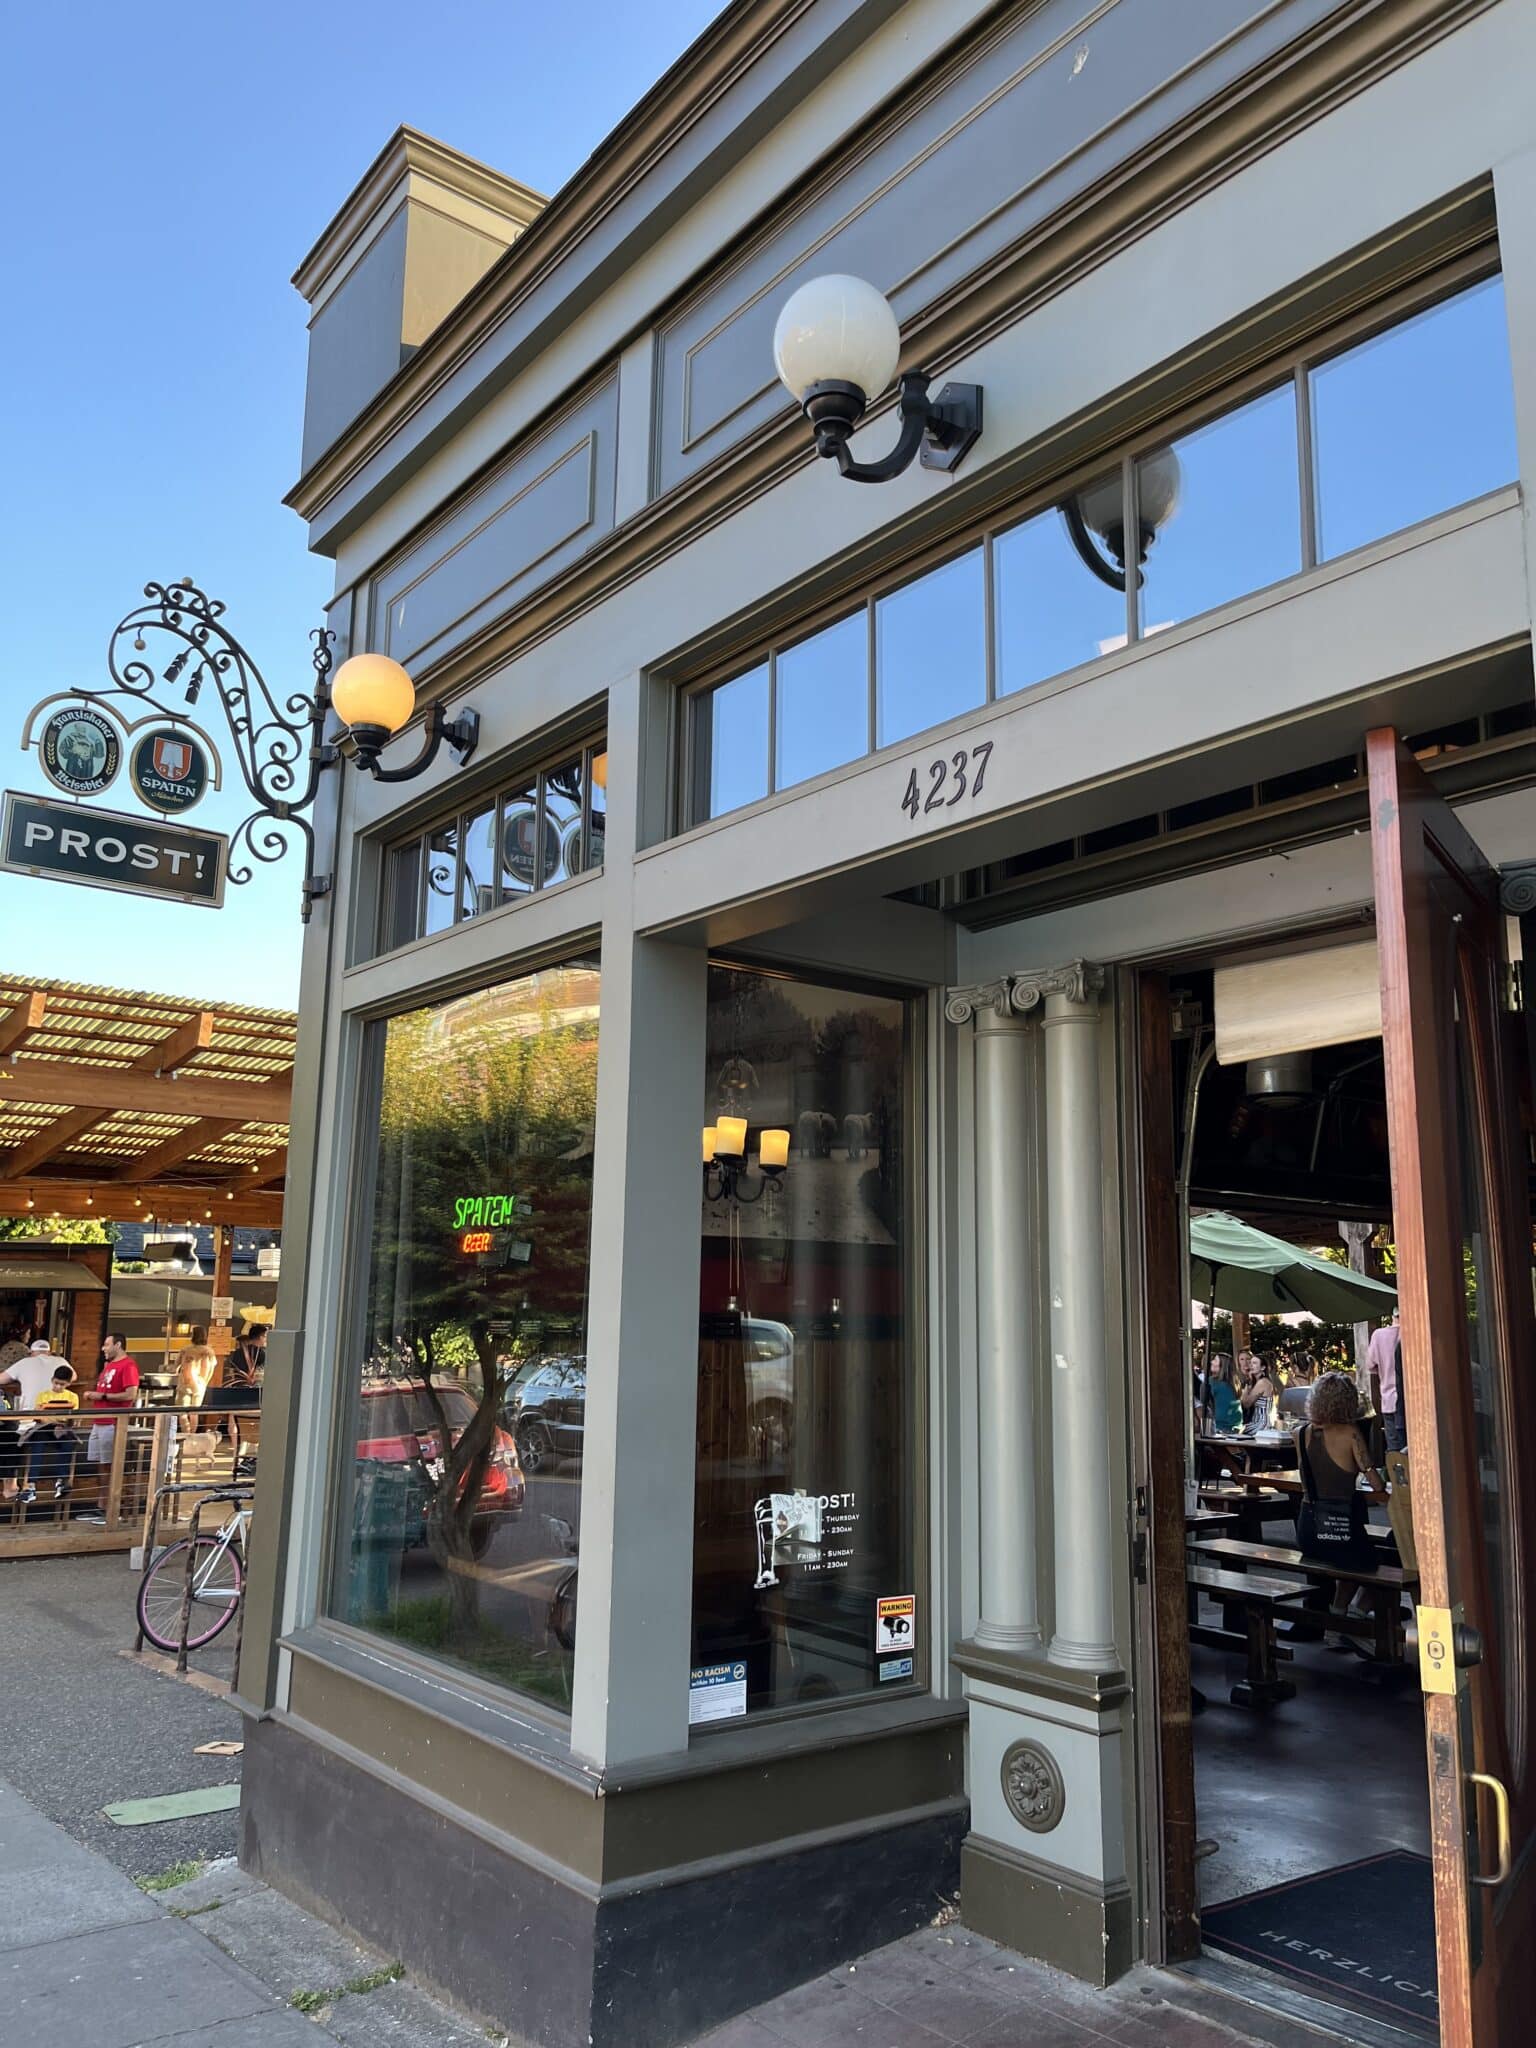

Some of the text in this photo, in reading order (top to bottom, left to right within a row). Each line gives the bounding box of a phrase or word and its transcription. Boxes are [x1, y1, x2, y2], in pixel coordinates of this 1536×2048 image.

[55, 770, 105, 791] Weissbier
[141, 776, 197, 798] SPATEN
[901, 741, 994, 820] 4237
[24, 822, 205, 880] PROST!
[453, 1195, 515, 1229] SPATEN
[819, 1493, 855, 1509] OST!
[826, 1513, 860, 1522] THURSDAY
[797, 1552, 821, 1561] FRIDAY
[827, 1549, 854, 1557] SUNDAY
[881, 1602, 912, 1613] WARNING
[692, 1665, 731, 1678] NO RACISM
